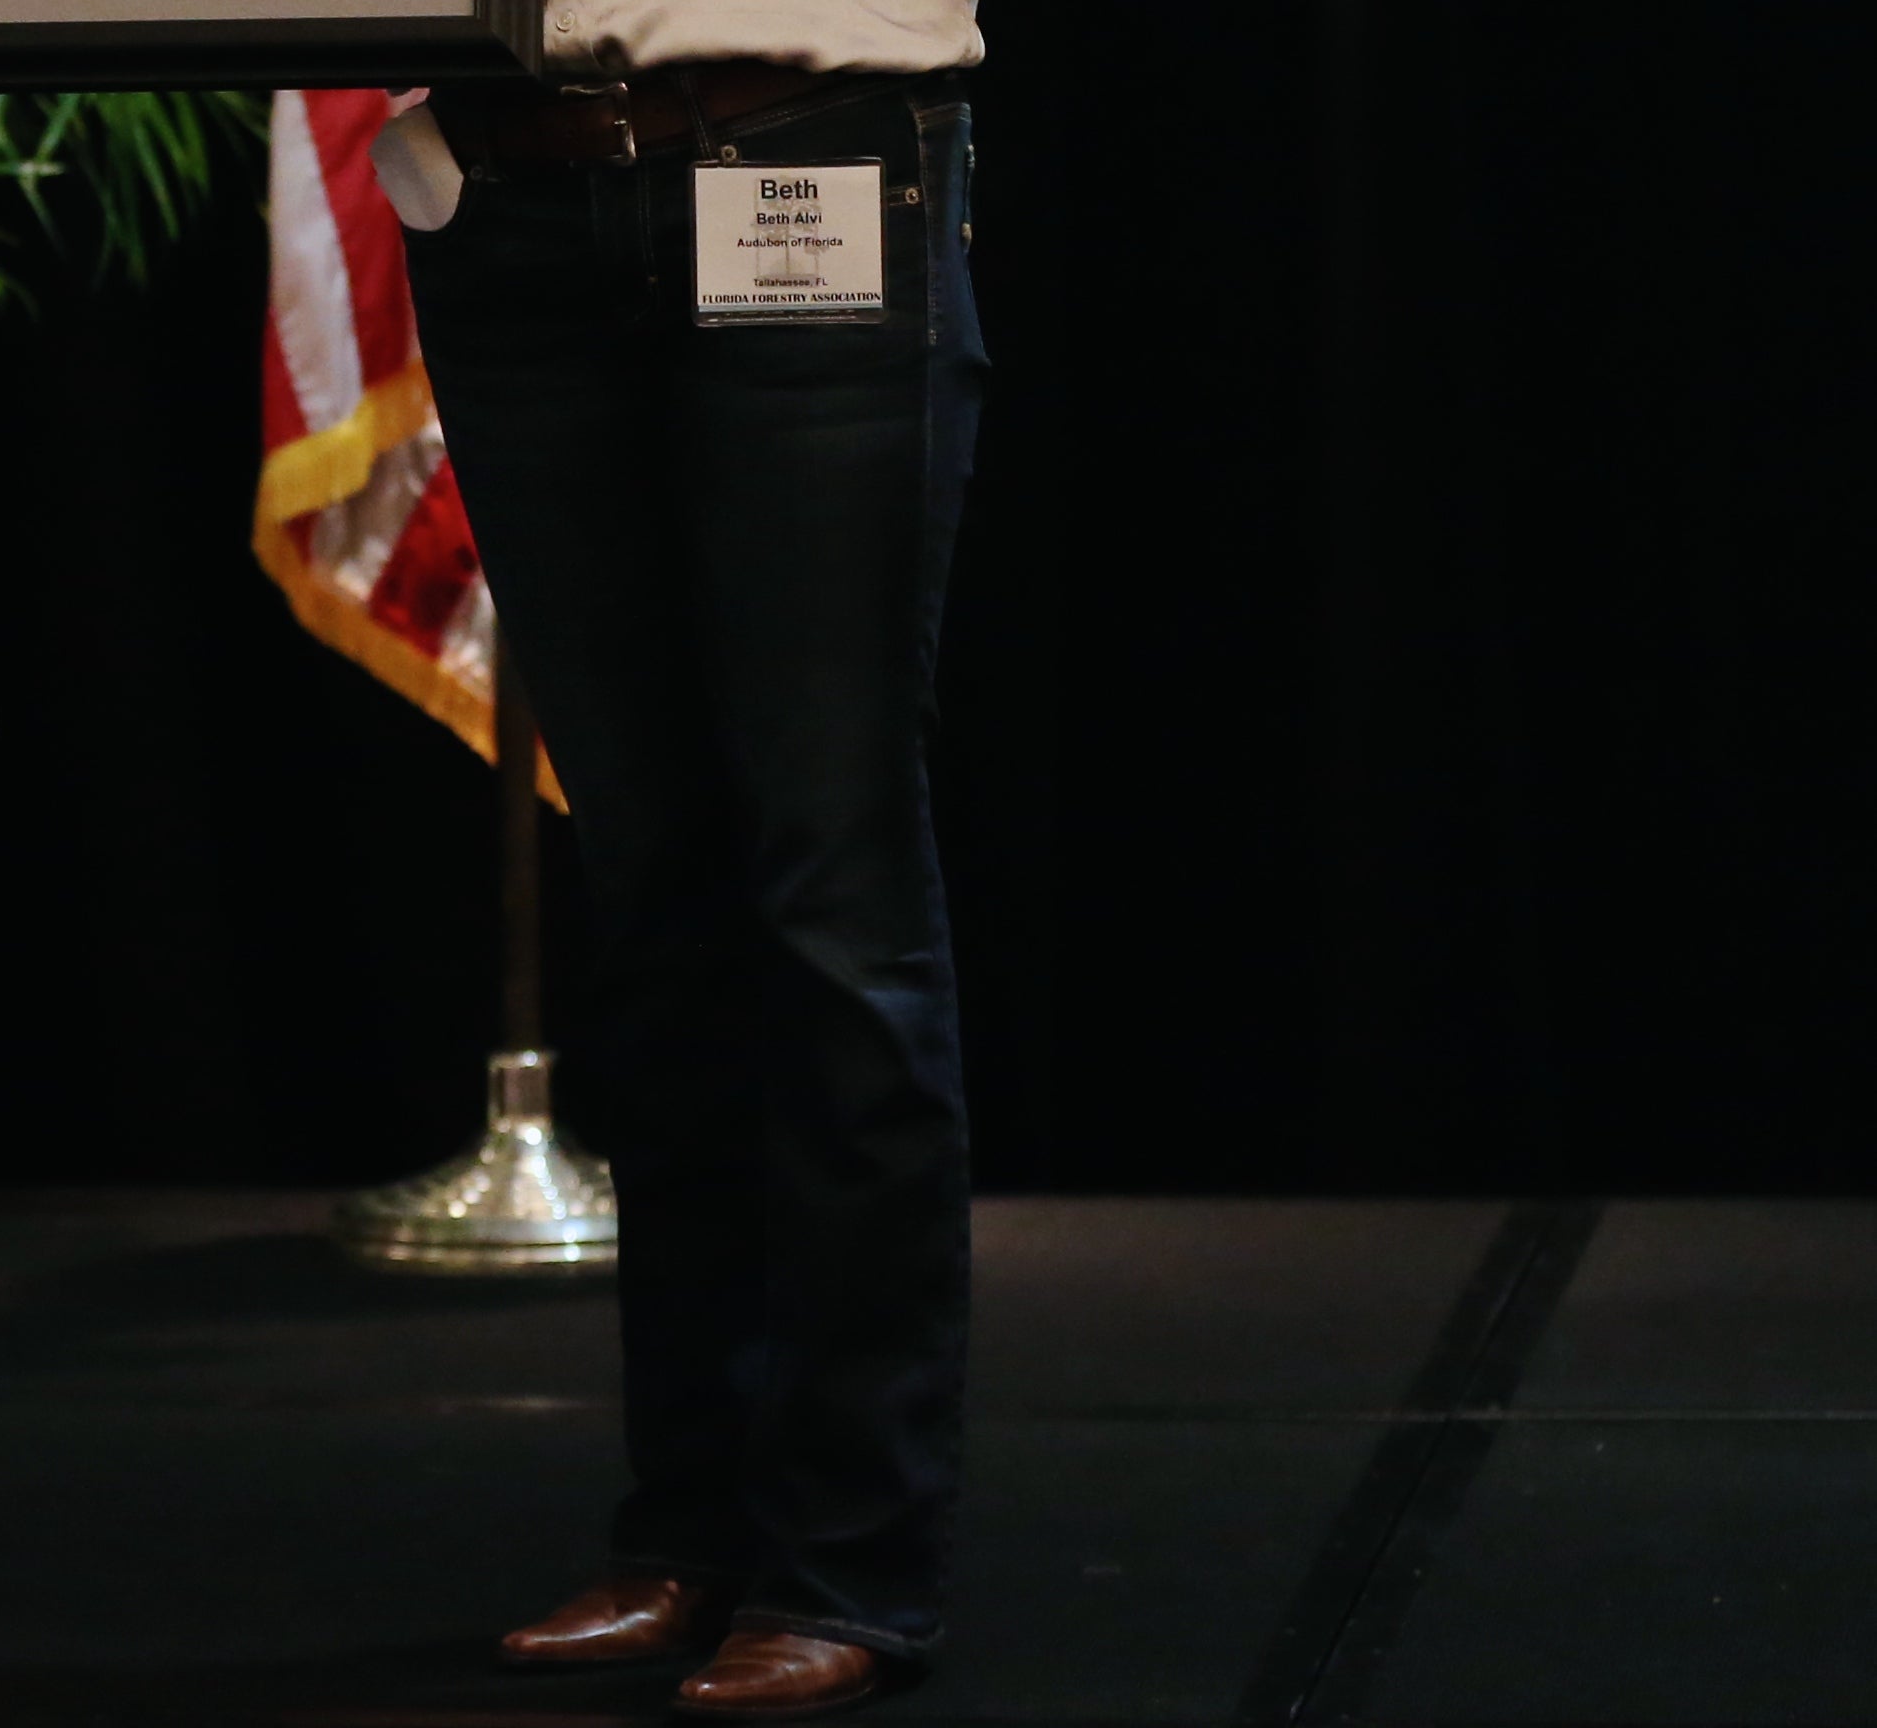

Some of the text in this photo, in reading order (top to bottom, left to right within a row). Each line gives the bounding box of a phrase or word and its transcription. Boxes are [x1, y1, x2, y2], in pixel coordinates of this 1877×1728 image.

[760, 179, 818, 200] Beth
[756, 212, 822, 225] Beth Alvi
[737, 237, 843, 248] Audubon of Florida
[753, 277, 828, 288] Tallahassee, FL
[702, 291, 882, 304] FLORIDA FORESTRY ASSOCIATION
